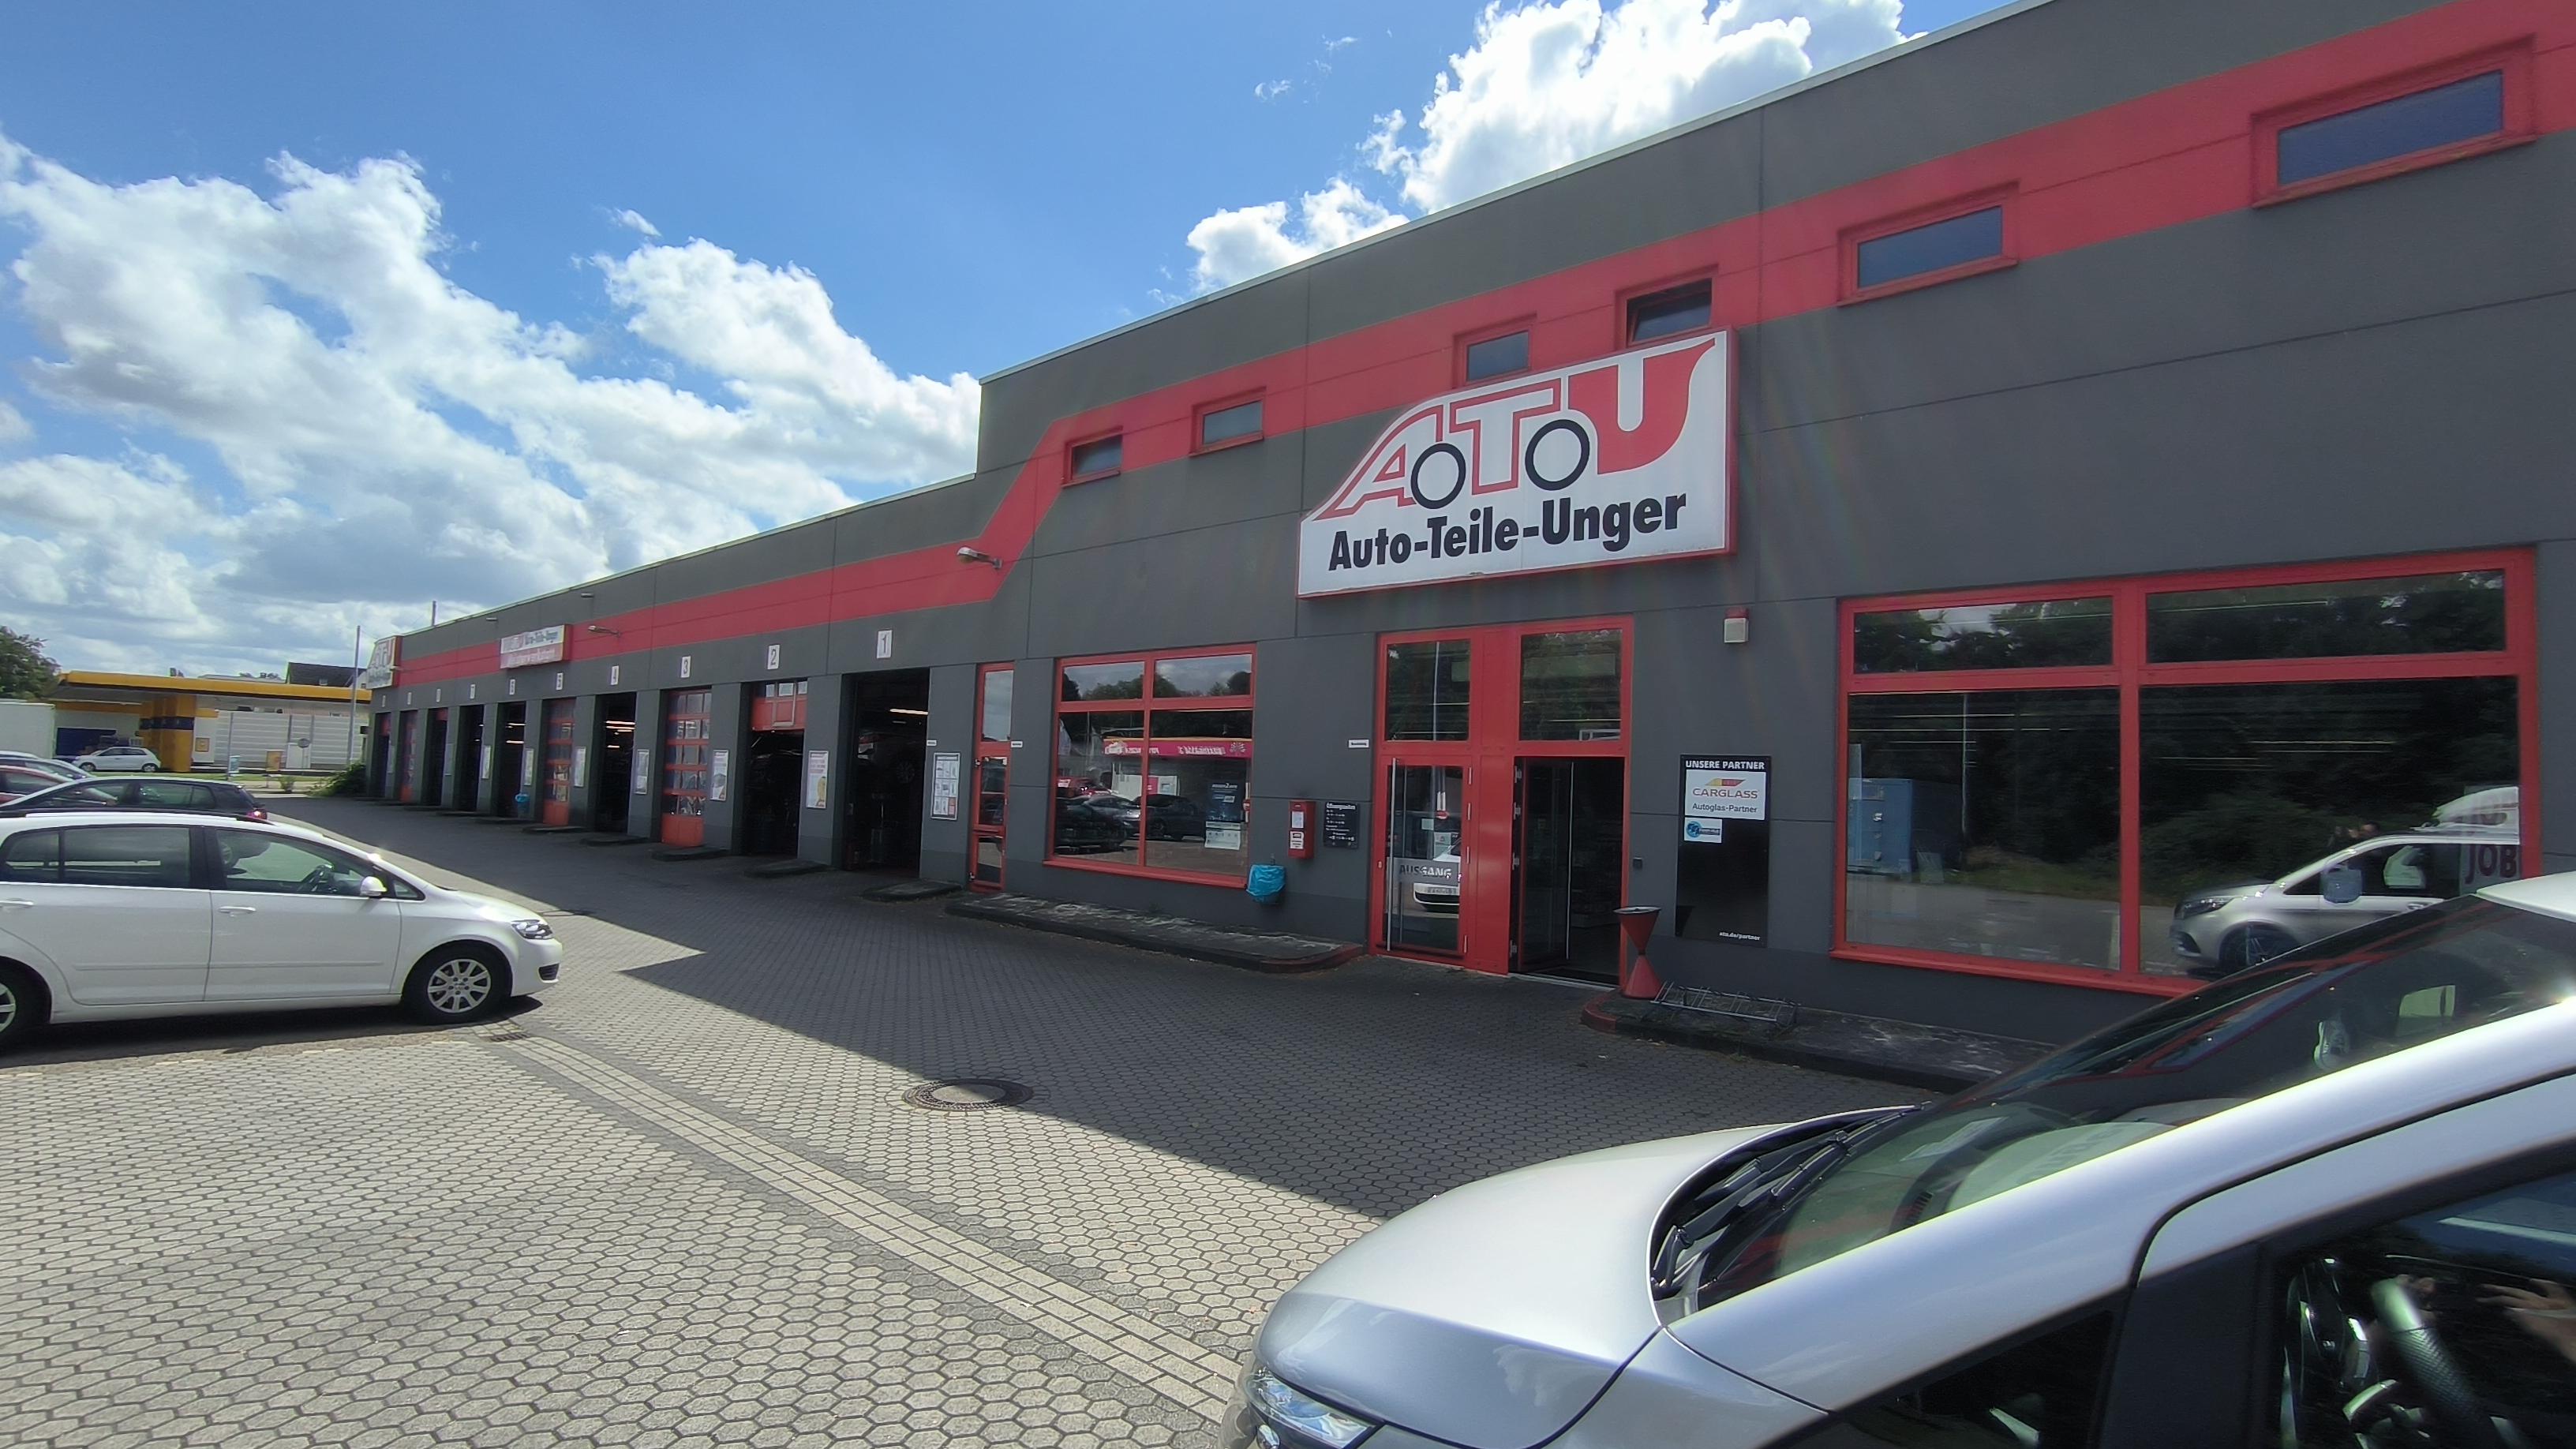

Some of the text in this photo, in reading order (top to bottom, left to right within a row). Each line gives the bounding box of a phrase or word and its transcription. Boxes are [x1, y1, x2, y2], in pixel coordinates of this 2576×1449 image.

[1315, 338, 1715, 521] ATU
[1328, 492, 1687, 571] Auto-Teile-Unger
[769, 647, 777, 666] 2
[683, 657, 689, 676] 3
[1685, 760, 1765, 769] UNSERE PARTNER
[1692, 788, 1758, 799] CARGLASS
[1692, 803, 1758, 813] Autoglas-Partner
[1399, 864, 1452, 877] AUSGANG
[2464, 842, 2518, 885] JOB
